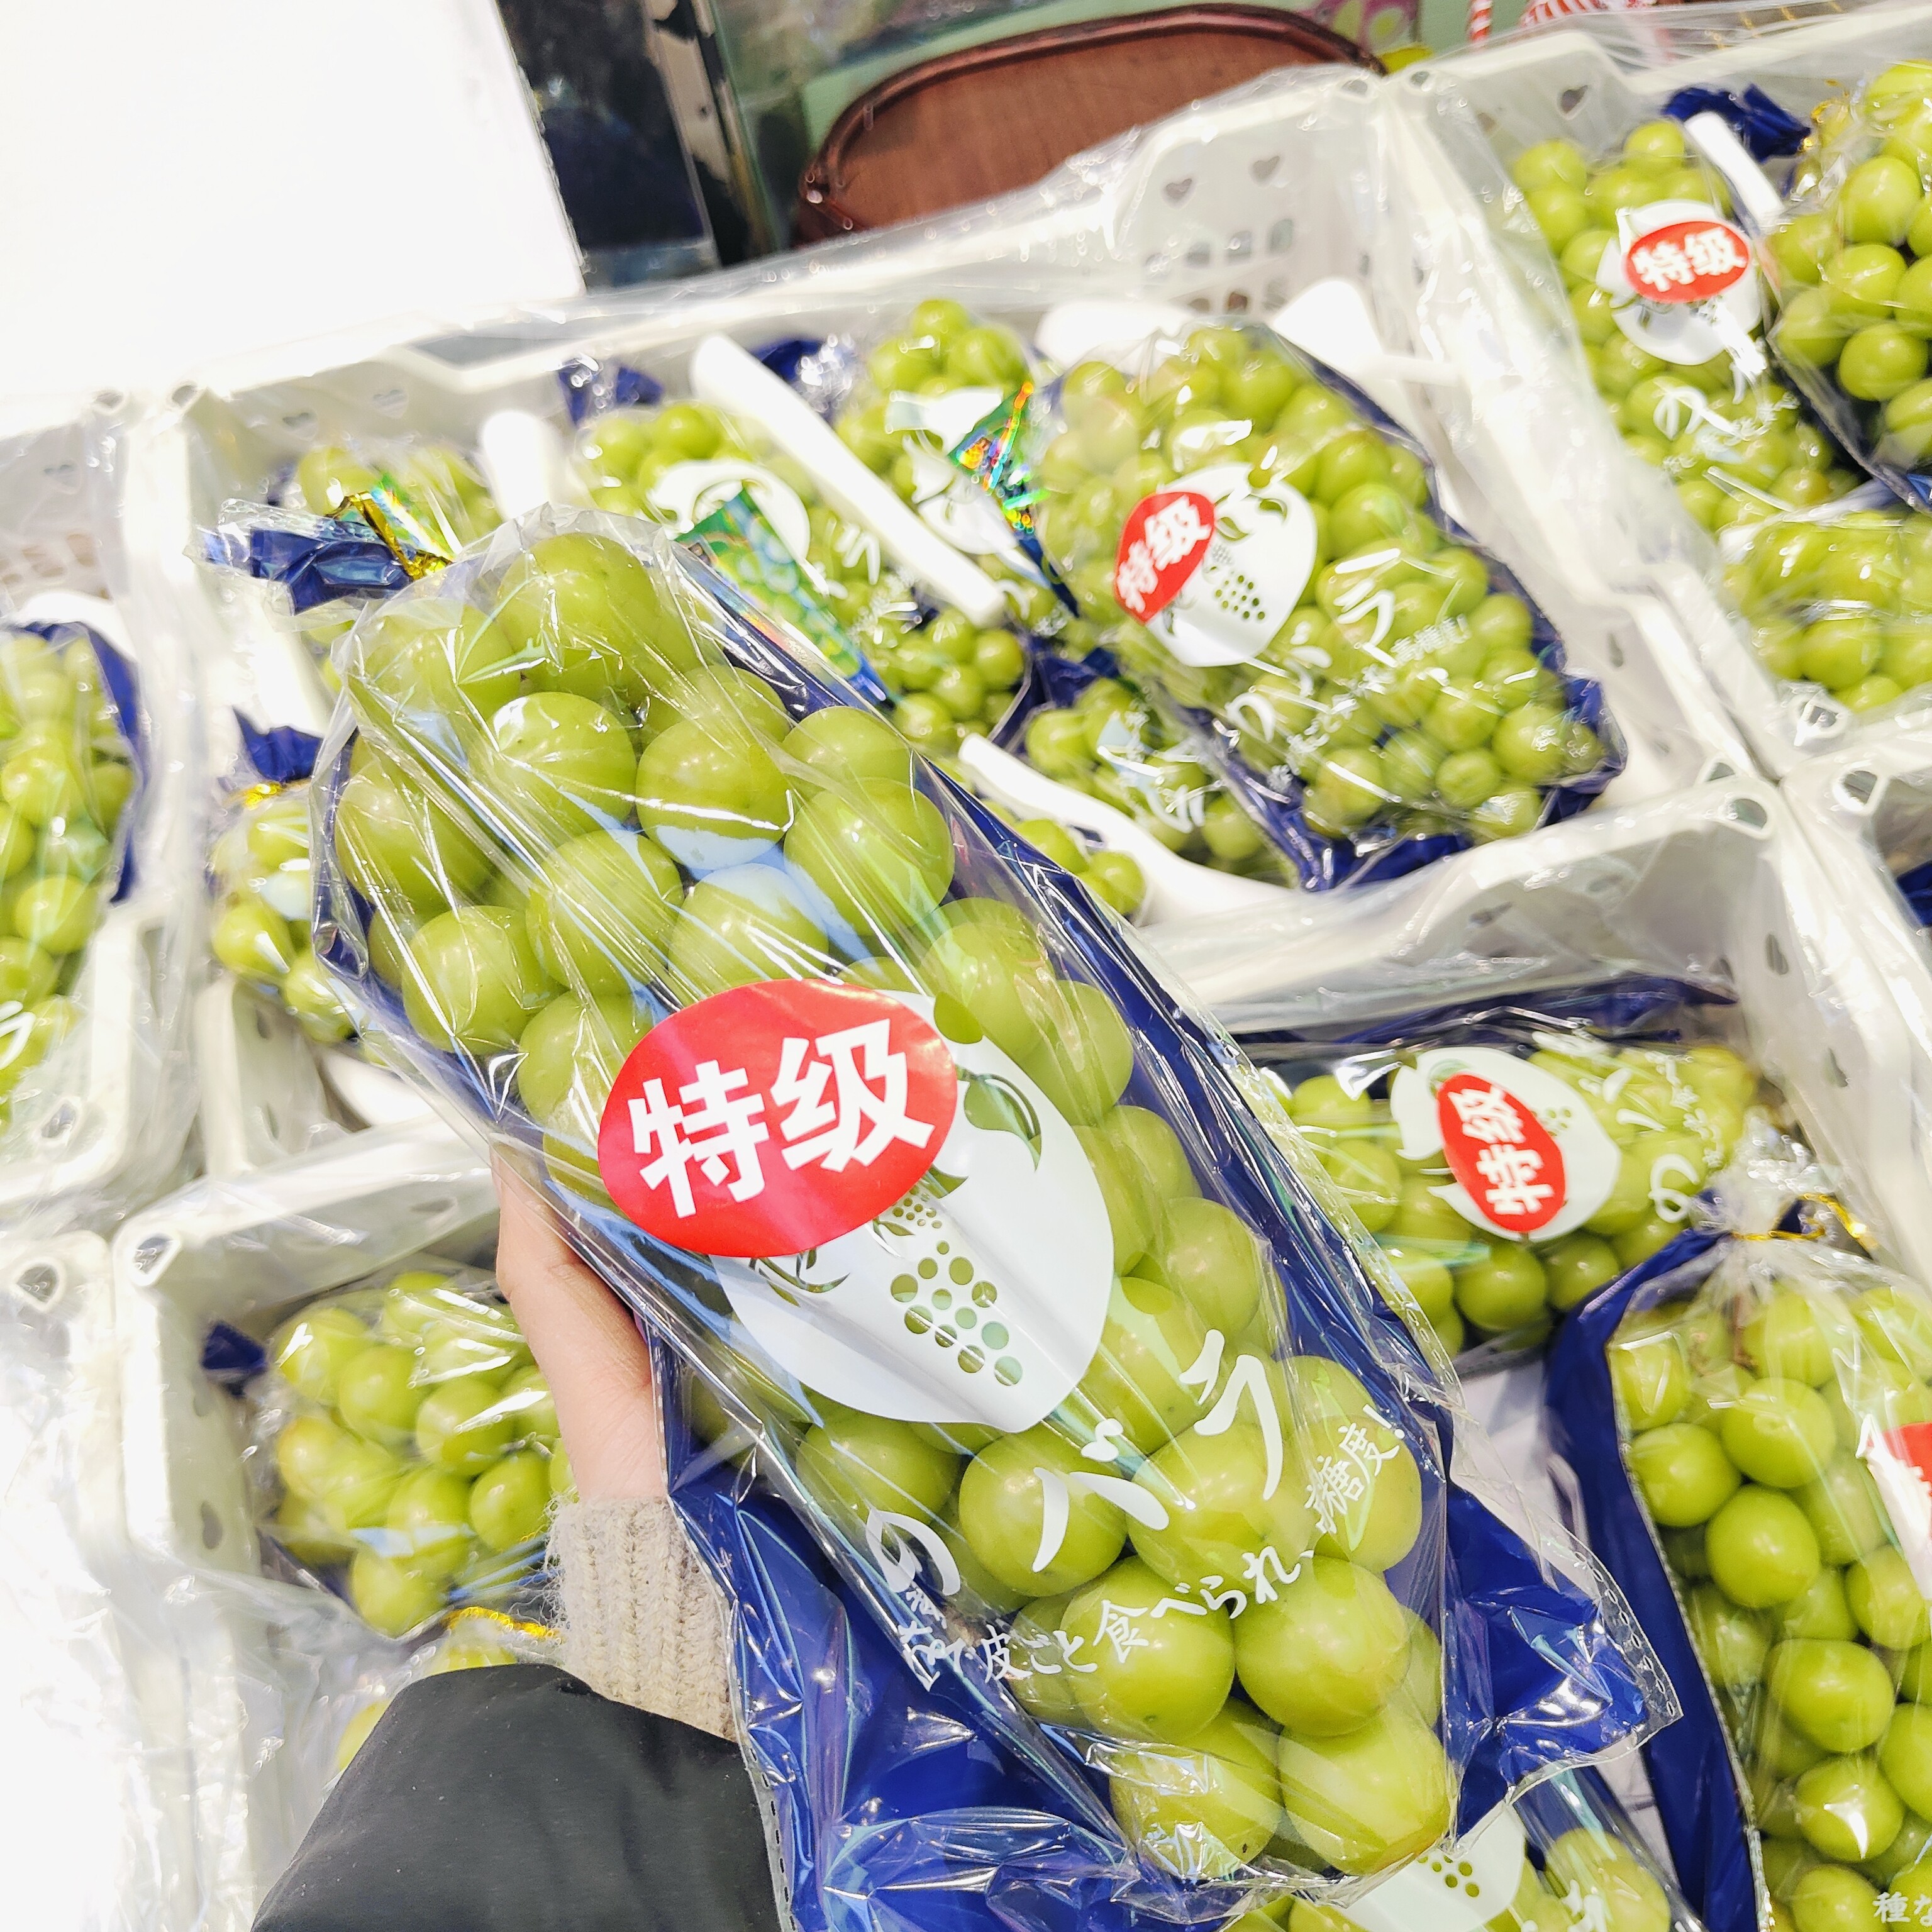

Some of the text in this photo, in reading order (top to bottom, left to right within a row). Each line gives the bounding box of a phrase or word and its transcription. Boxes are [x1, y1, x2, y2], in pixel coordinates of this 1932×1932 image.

[1631, 226, 1746, 292] 特级
[1117, 495, 1213, 613] 特级
[628, 1018, 935, 1218] 特级
[1448, 1086, 1555, 1215] 特级
[866, 1329, 1283, 1596] のバラ
